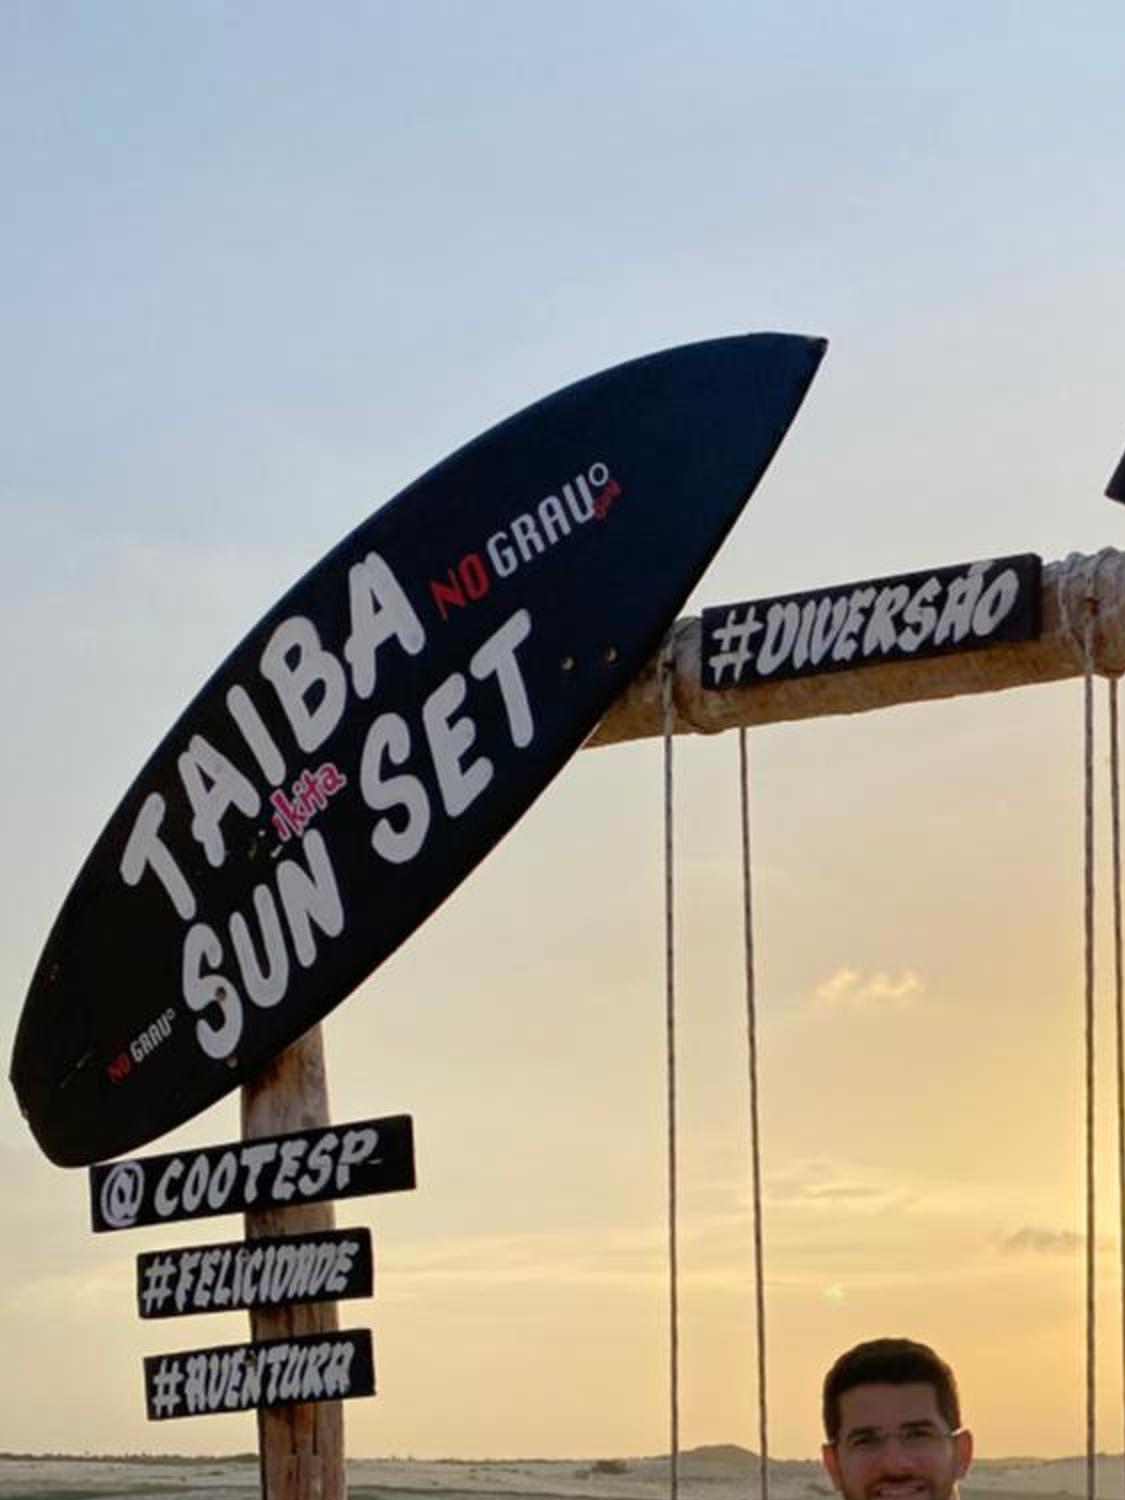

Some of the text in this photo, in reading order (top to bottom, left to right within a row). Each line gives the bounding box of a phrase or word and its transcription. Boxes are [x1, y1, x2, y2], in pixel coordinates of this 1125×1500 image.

[429, 552, 490, 621] NO
[709, 559, 1019, 685] #DIVERSÃO
[120, 552, 425, 920] TAIBA
[182, 608, 536, 1061] SUN SET
